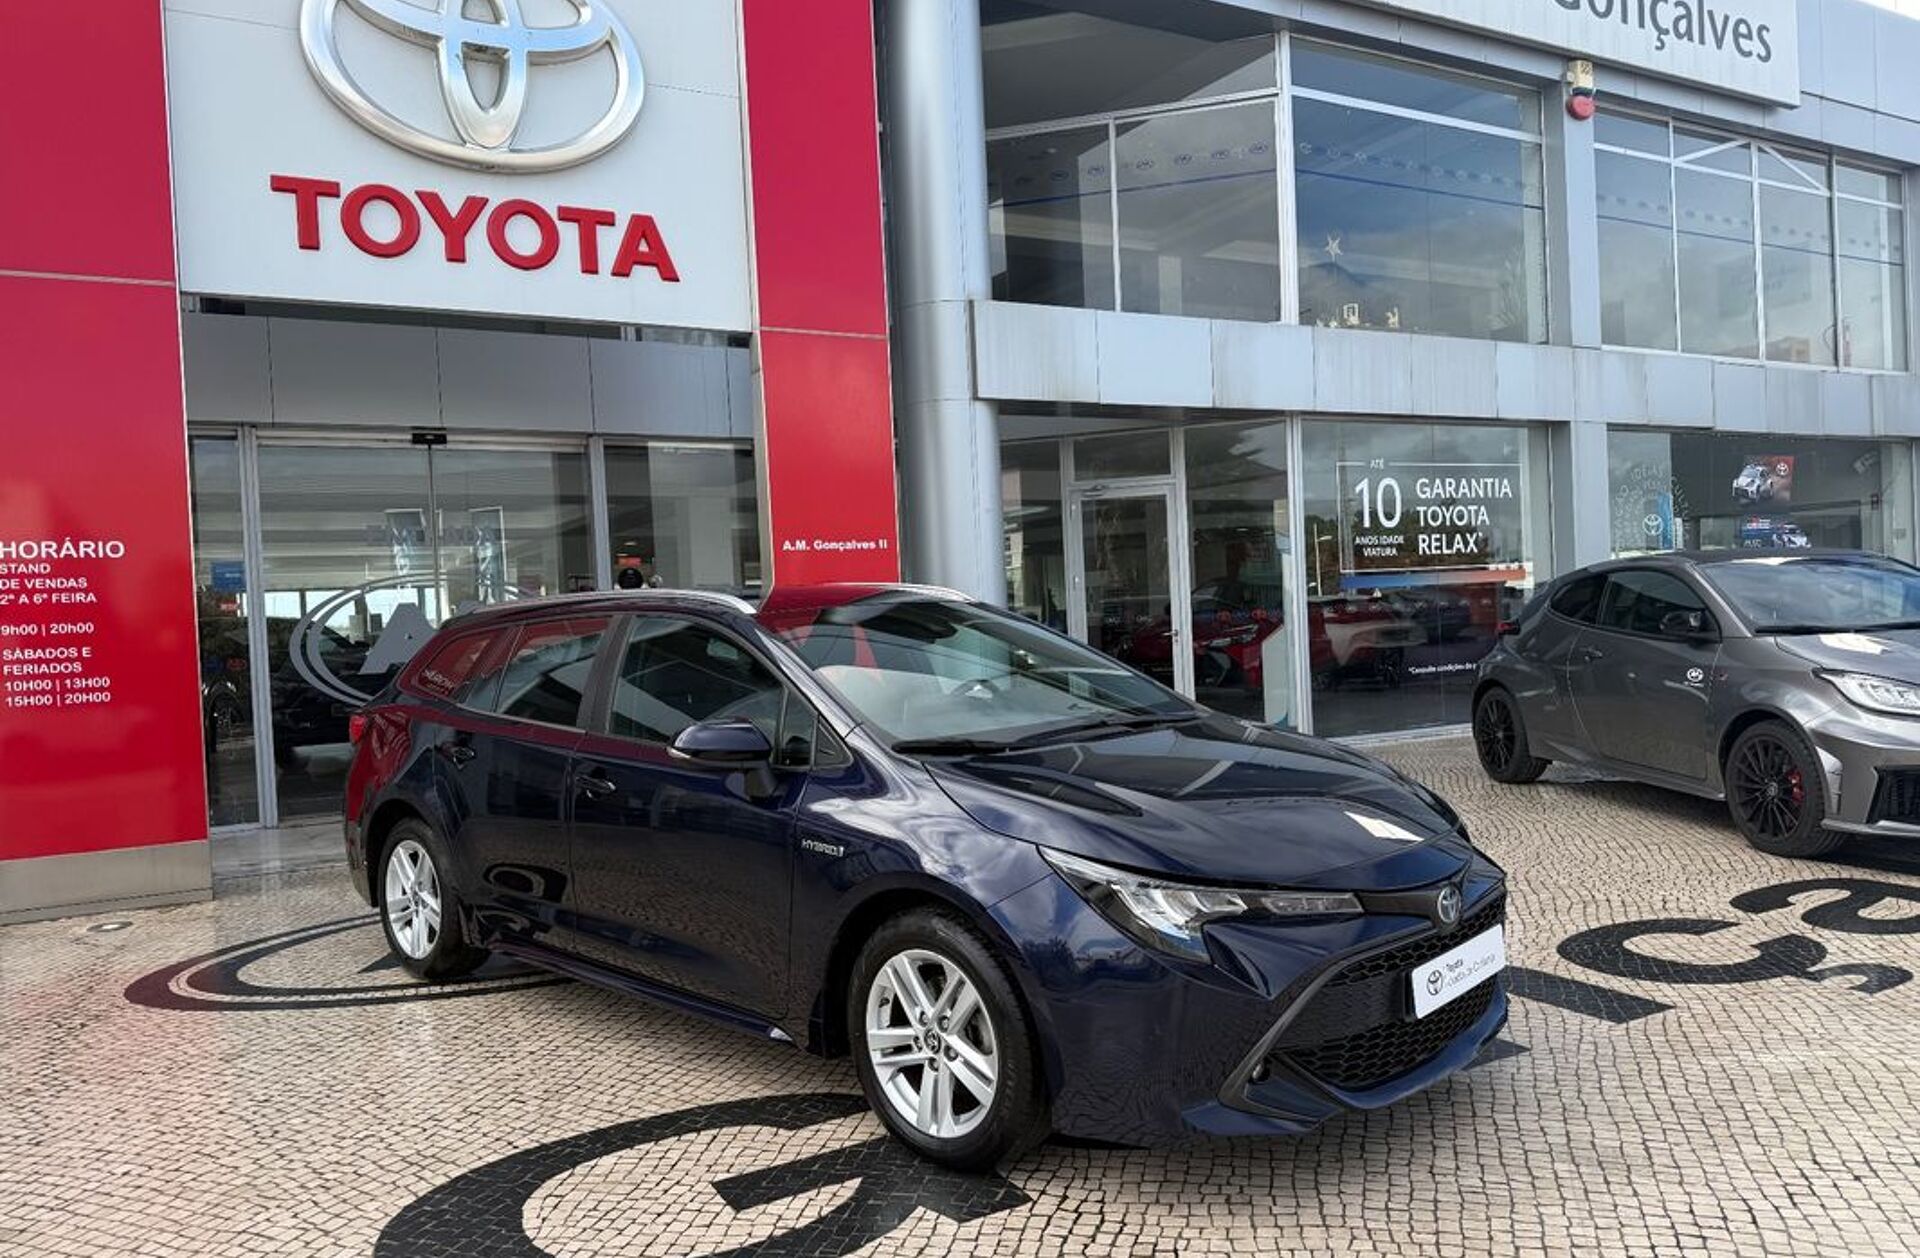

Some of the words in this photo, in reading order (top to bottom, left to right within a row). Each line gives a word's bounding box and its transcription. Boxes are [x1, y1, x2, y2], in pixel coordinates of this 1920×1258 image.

[271, 174, 679, 282] TOYOTA
[1416, 478, 1512, 499] GARANTIA
[1355, 477, 1402, 528] 10
[1416, 505, 1490, 527] TOYOTA
[0, 537, 125, 558] HORÁRIO
[782, 540, 811, 551] A.M.
[813, 539, 876, 552] Gonçalves
[1354, 536, 1379, 545] ANOS
[1363, 547, 1398, 557] VIATURA
[0, 563, 51, 574] STAND
[0, 579, 20, 589] DE
[25, 577, 88, 589] VENDAS
[19, 594, 29, 604] A
[52, 592, 97, 604] FEIRA
[1, 624, 38, 636] 9h00
[50, 622, 95, 634] 20h00
[3, 647, 79, 661] SÁBADOS
[82, 647, 92, 657] E
[3, 662, 82, 676] FERIADOS
[5, 680, 52, 691] 10H00
[65, 676, 111, 689] 13H00
[6, 694, 53, 707] 15H00
[65, 692, 111, 704] 20H00
